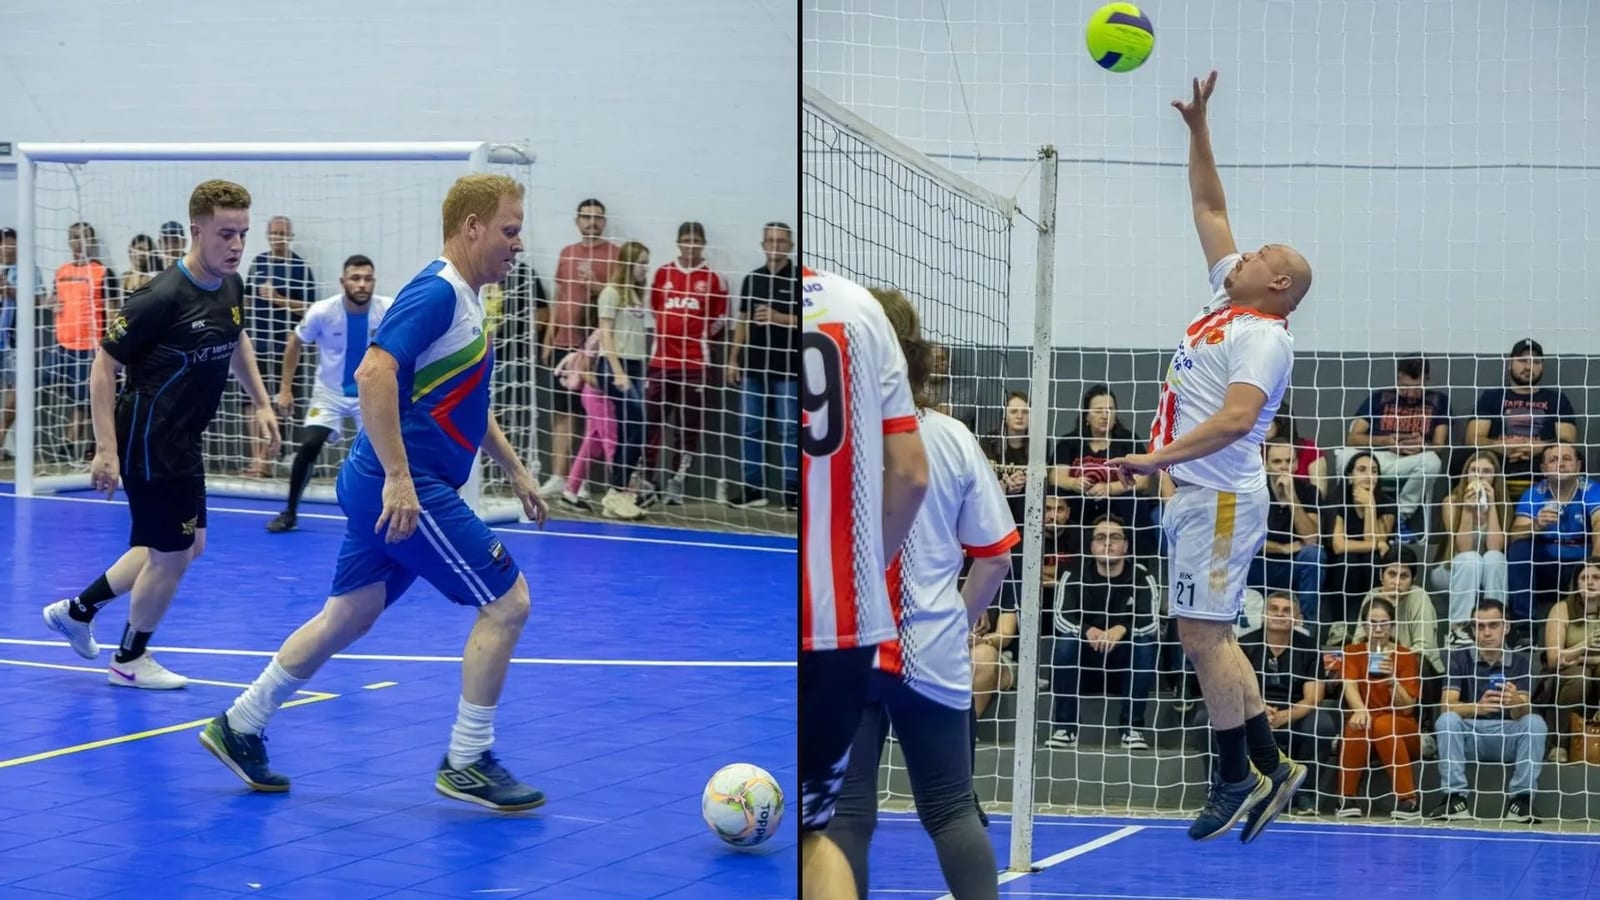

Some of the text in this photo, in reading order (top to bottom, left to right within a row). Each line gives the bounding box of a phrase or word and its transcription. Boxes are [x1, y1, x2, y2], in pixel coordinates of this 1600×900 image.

[802, 332, 844, 457] 9
[1176, 581, 1196, 607] 21
[751, 803, 770, 845] Topp
